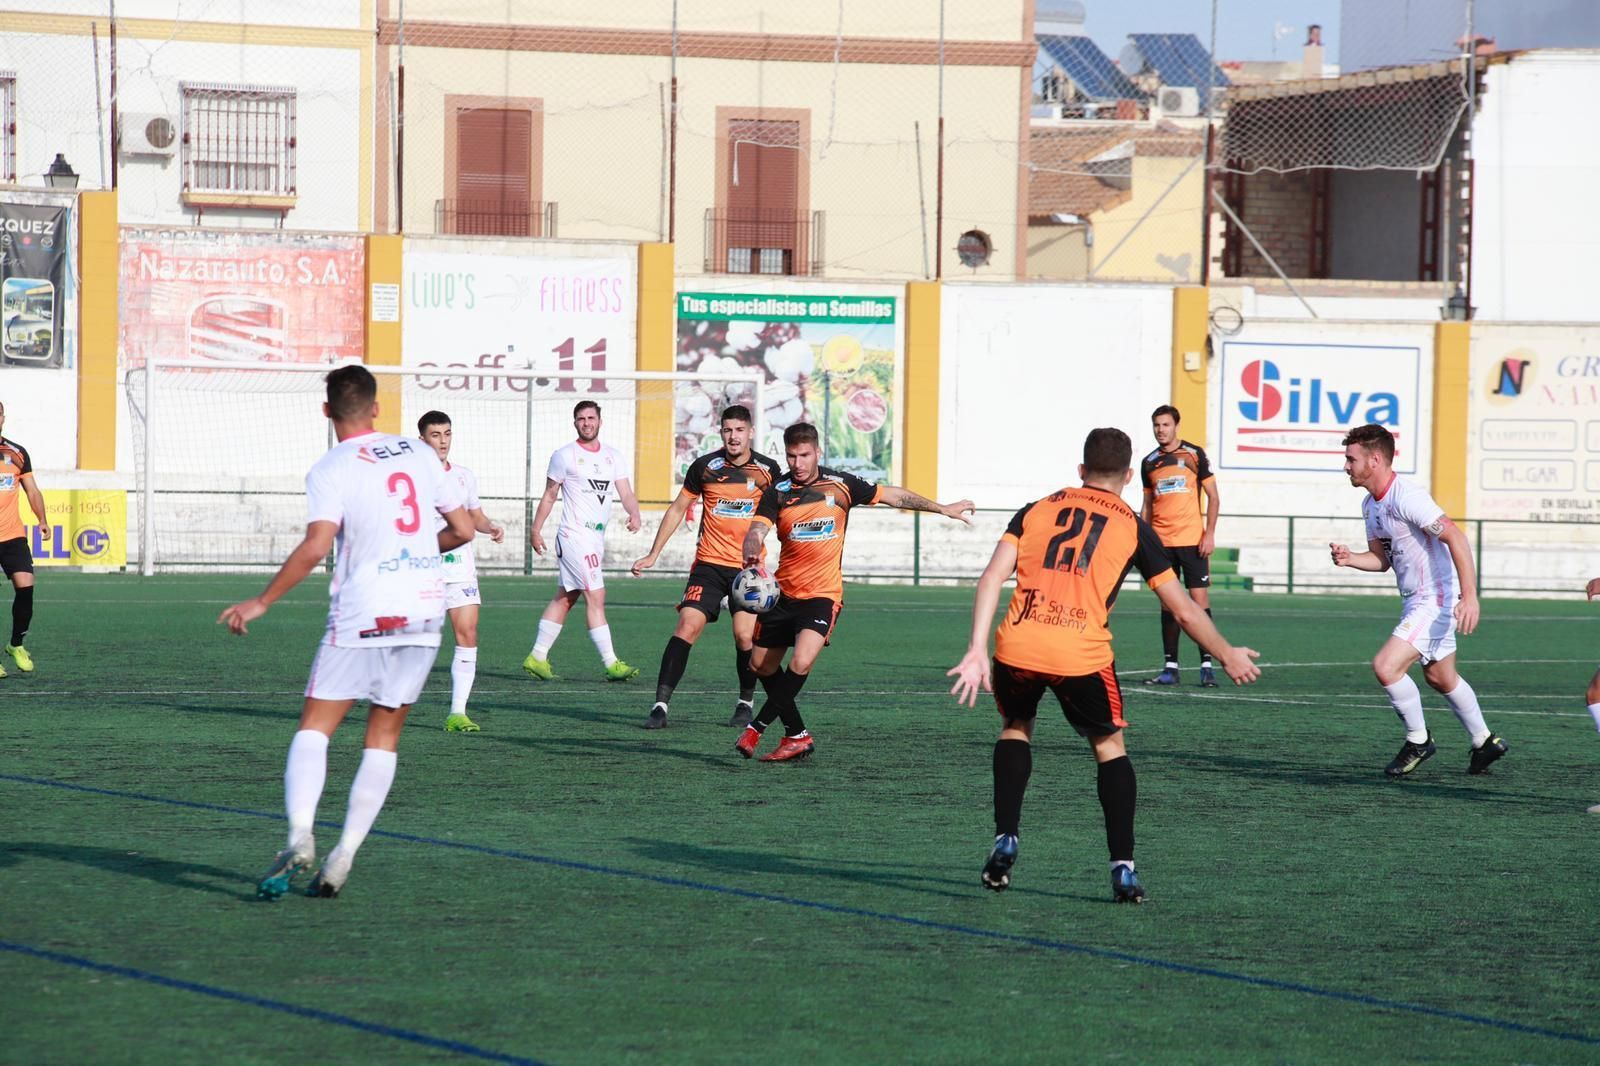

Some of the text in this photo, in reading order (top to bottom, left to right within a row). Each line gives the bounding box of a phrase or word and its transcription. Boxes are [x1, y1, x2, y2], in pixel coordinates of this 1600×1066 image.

[681, 296, 892, 317] Tus especialistas en Semillas
[1238, 359, 1400, 426] Silva
[40, 502, 111, 515] esde 1955
[387, 471, 421, 536] 3
[24, 525, 71, 558] LL
[1042, 507, 1109, 577] 21
[584, 553, 599, 569] 10
[687, 585, 704, 602] 22
[1028, 609, 1088, 634] Academy
